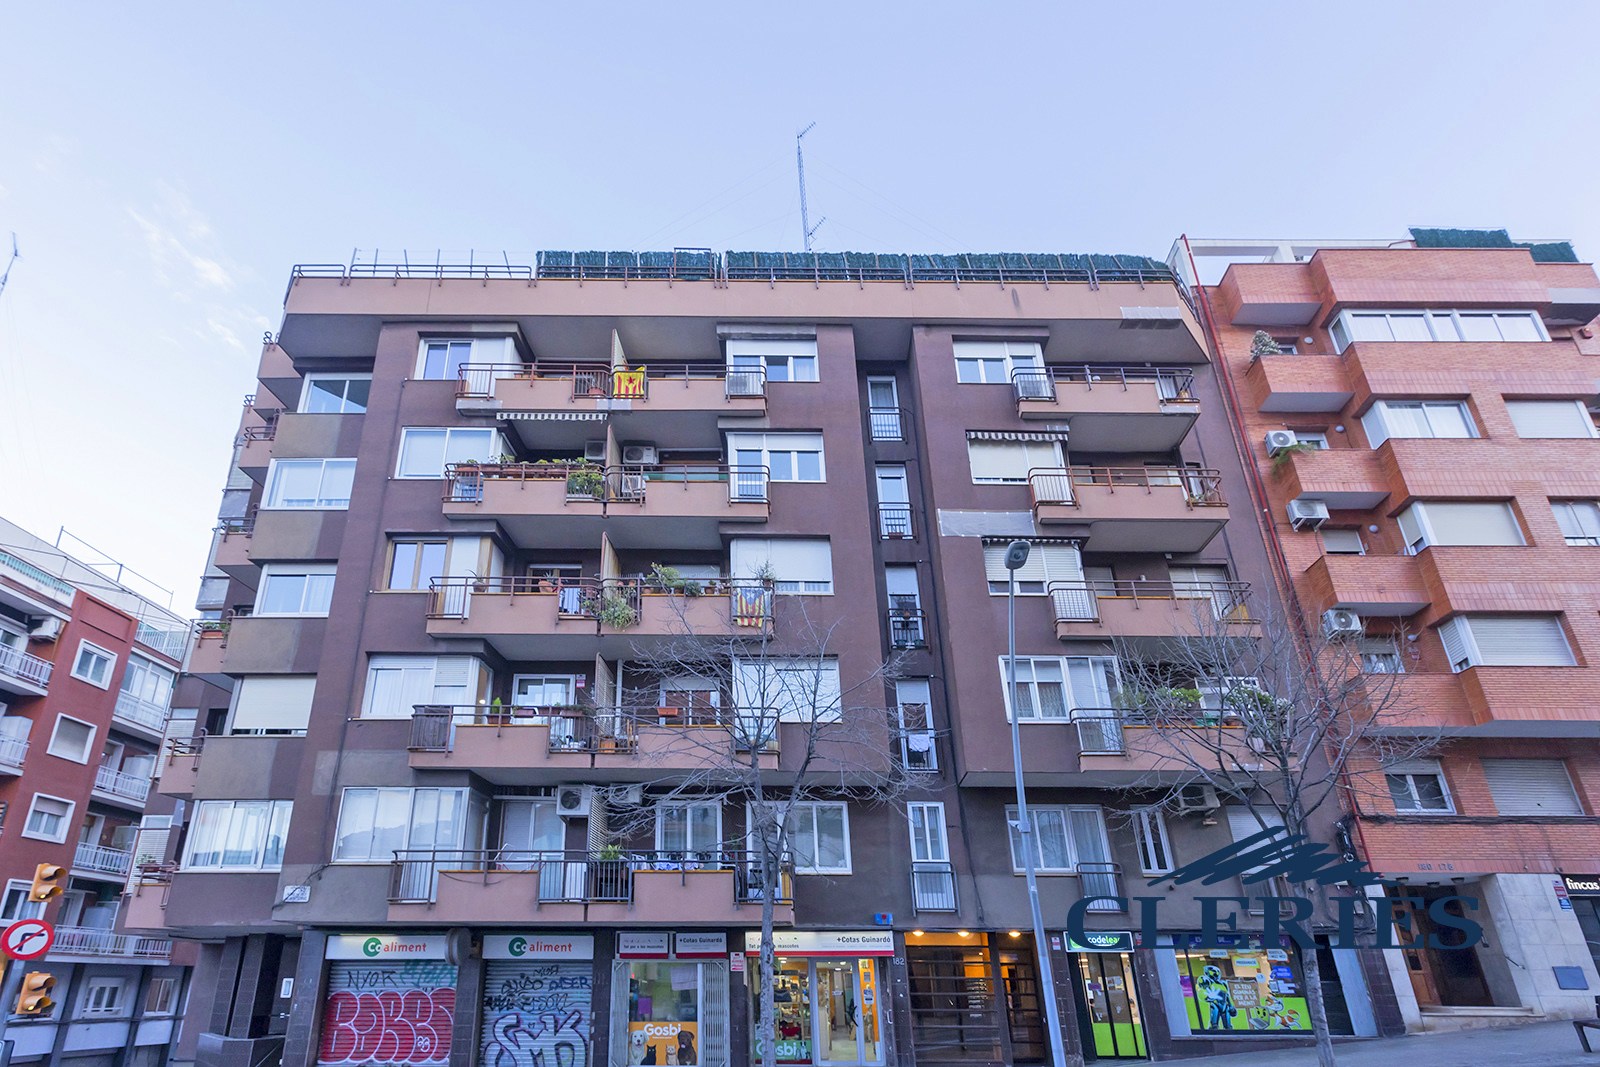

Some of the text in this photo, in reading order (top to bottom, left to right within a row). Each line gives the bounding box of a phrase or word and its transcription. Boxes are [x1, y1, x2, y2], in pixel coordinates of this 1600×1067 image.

[1565, 877, 1600, 890] fincas
[892, 957, 904, 966] 182
[644, 1023, 681, 1036] Gosbi
